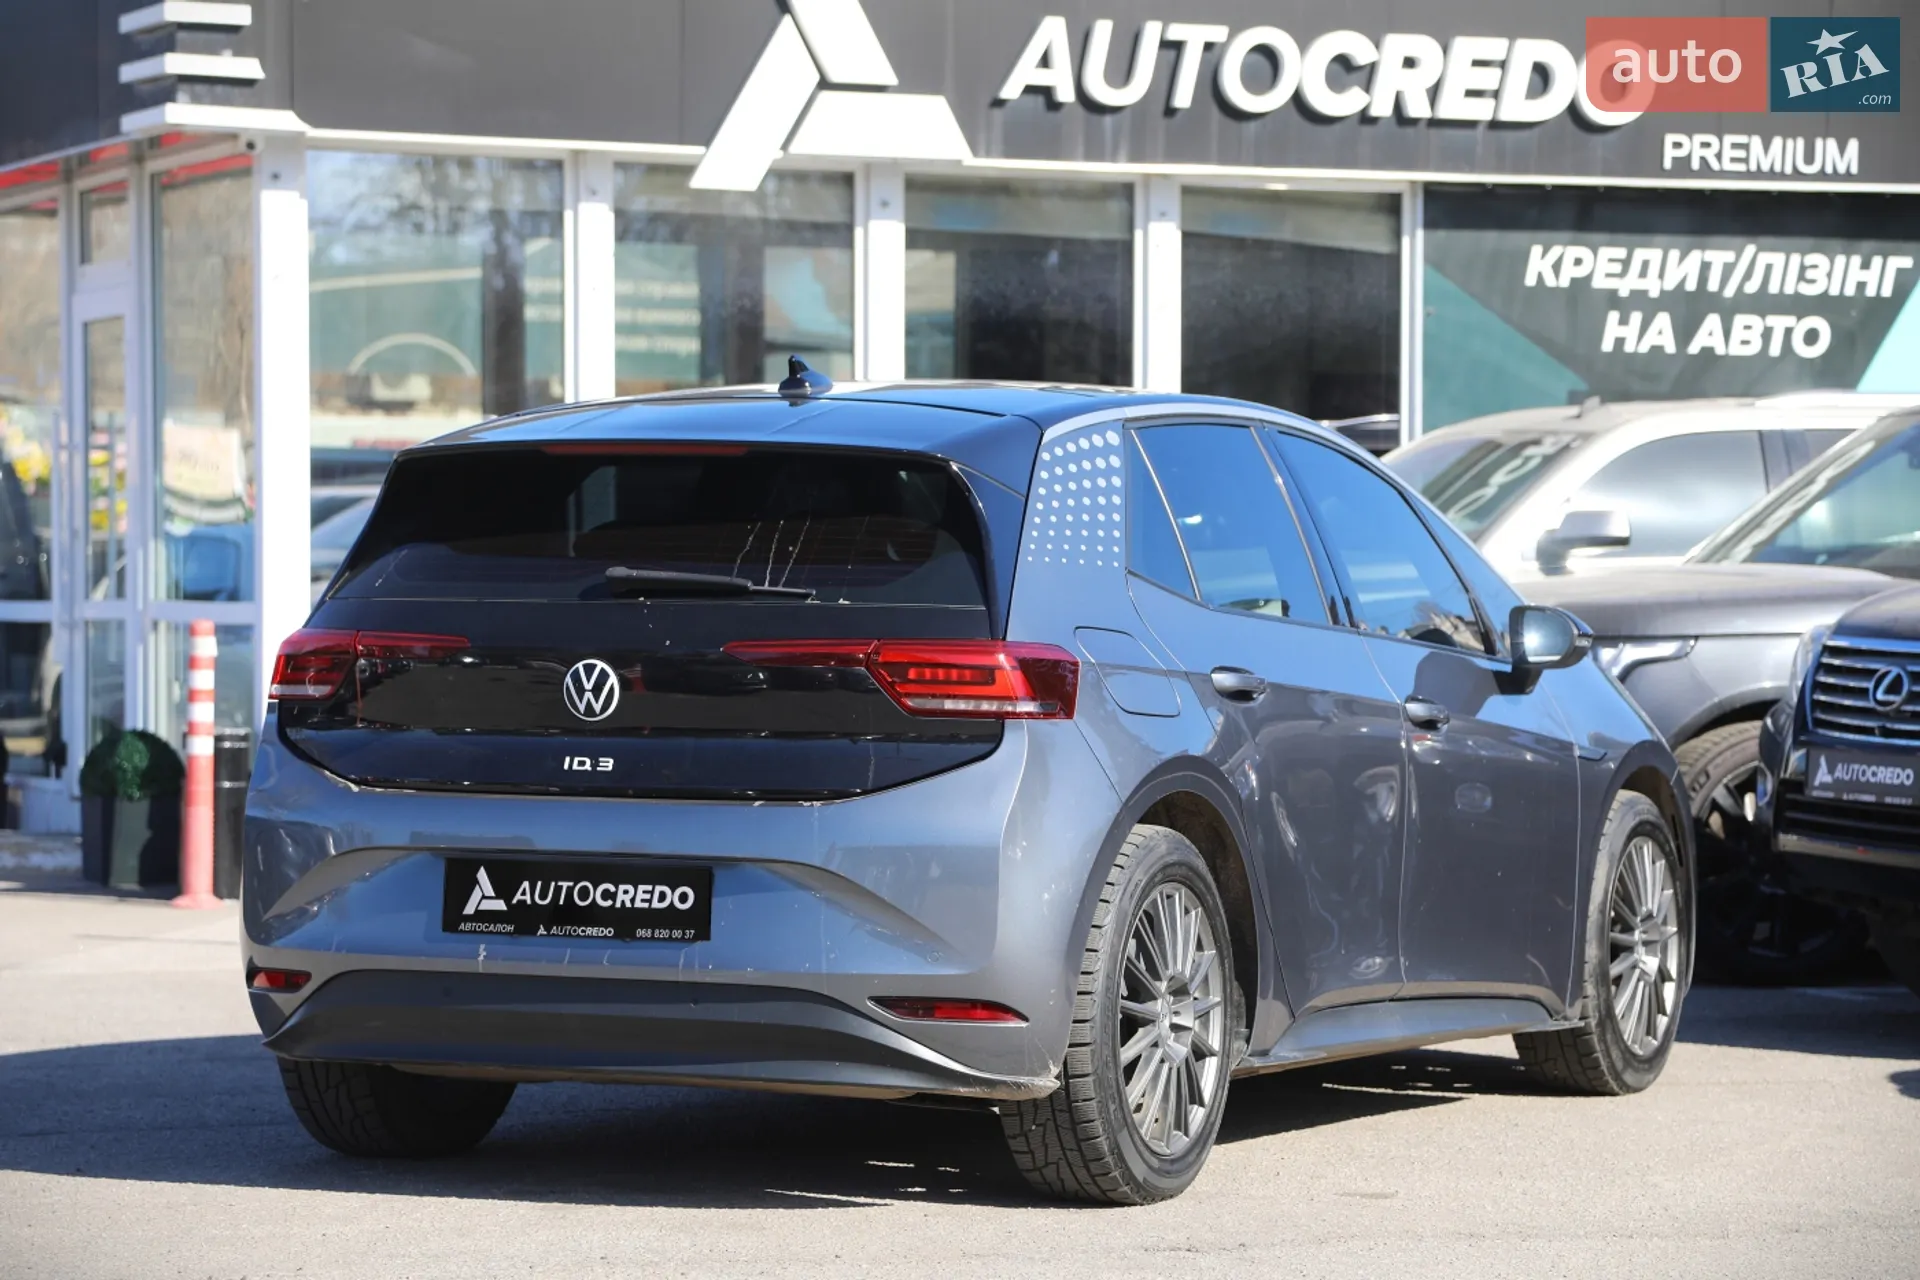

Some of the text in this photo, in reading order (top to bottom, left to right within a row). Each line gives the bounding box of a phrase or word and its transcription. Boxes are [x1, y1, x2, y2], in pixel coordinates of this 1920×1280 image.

[999, 14, 1655, 127] AUTOCREDO
[1662, 132, 1860, 176] PREMIUM
[1524, 243, 1914, 299] КРЕДИТ/ЛІЗІНГ
[1600, 310, 1832, 359] НА АВТО
[1833, 763, 1915, 786] AUTOCREDO
[511, 880, 696, 911] AUTOCREDO
[458, 921, 515, 933] АВТОСАЛОН
[550, 924, 615, 937] AUTOCREDO
[636, 928, 696, 939] 068 820 00 37
